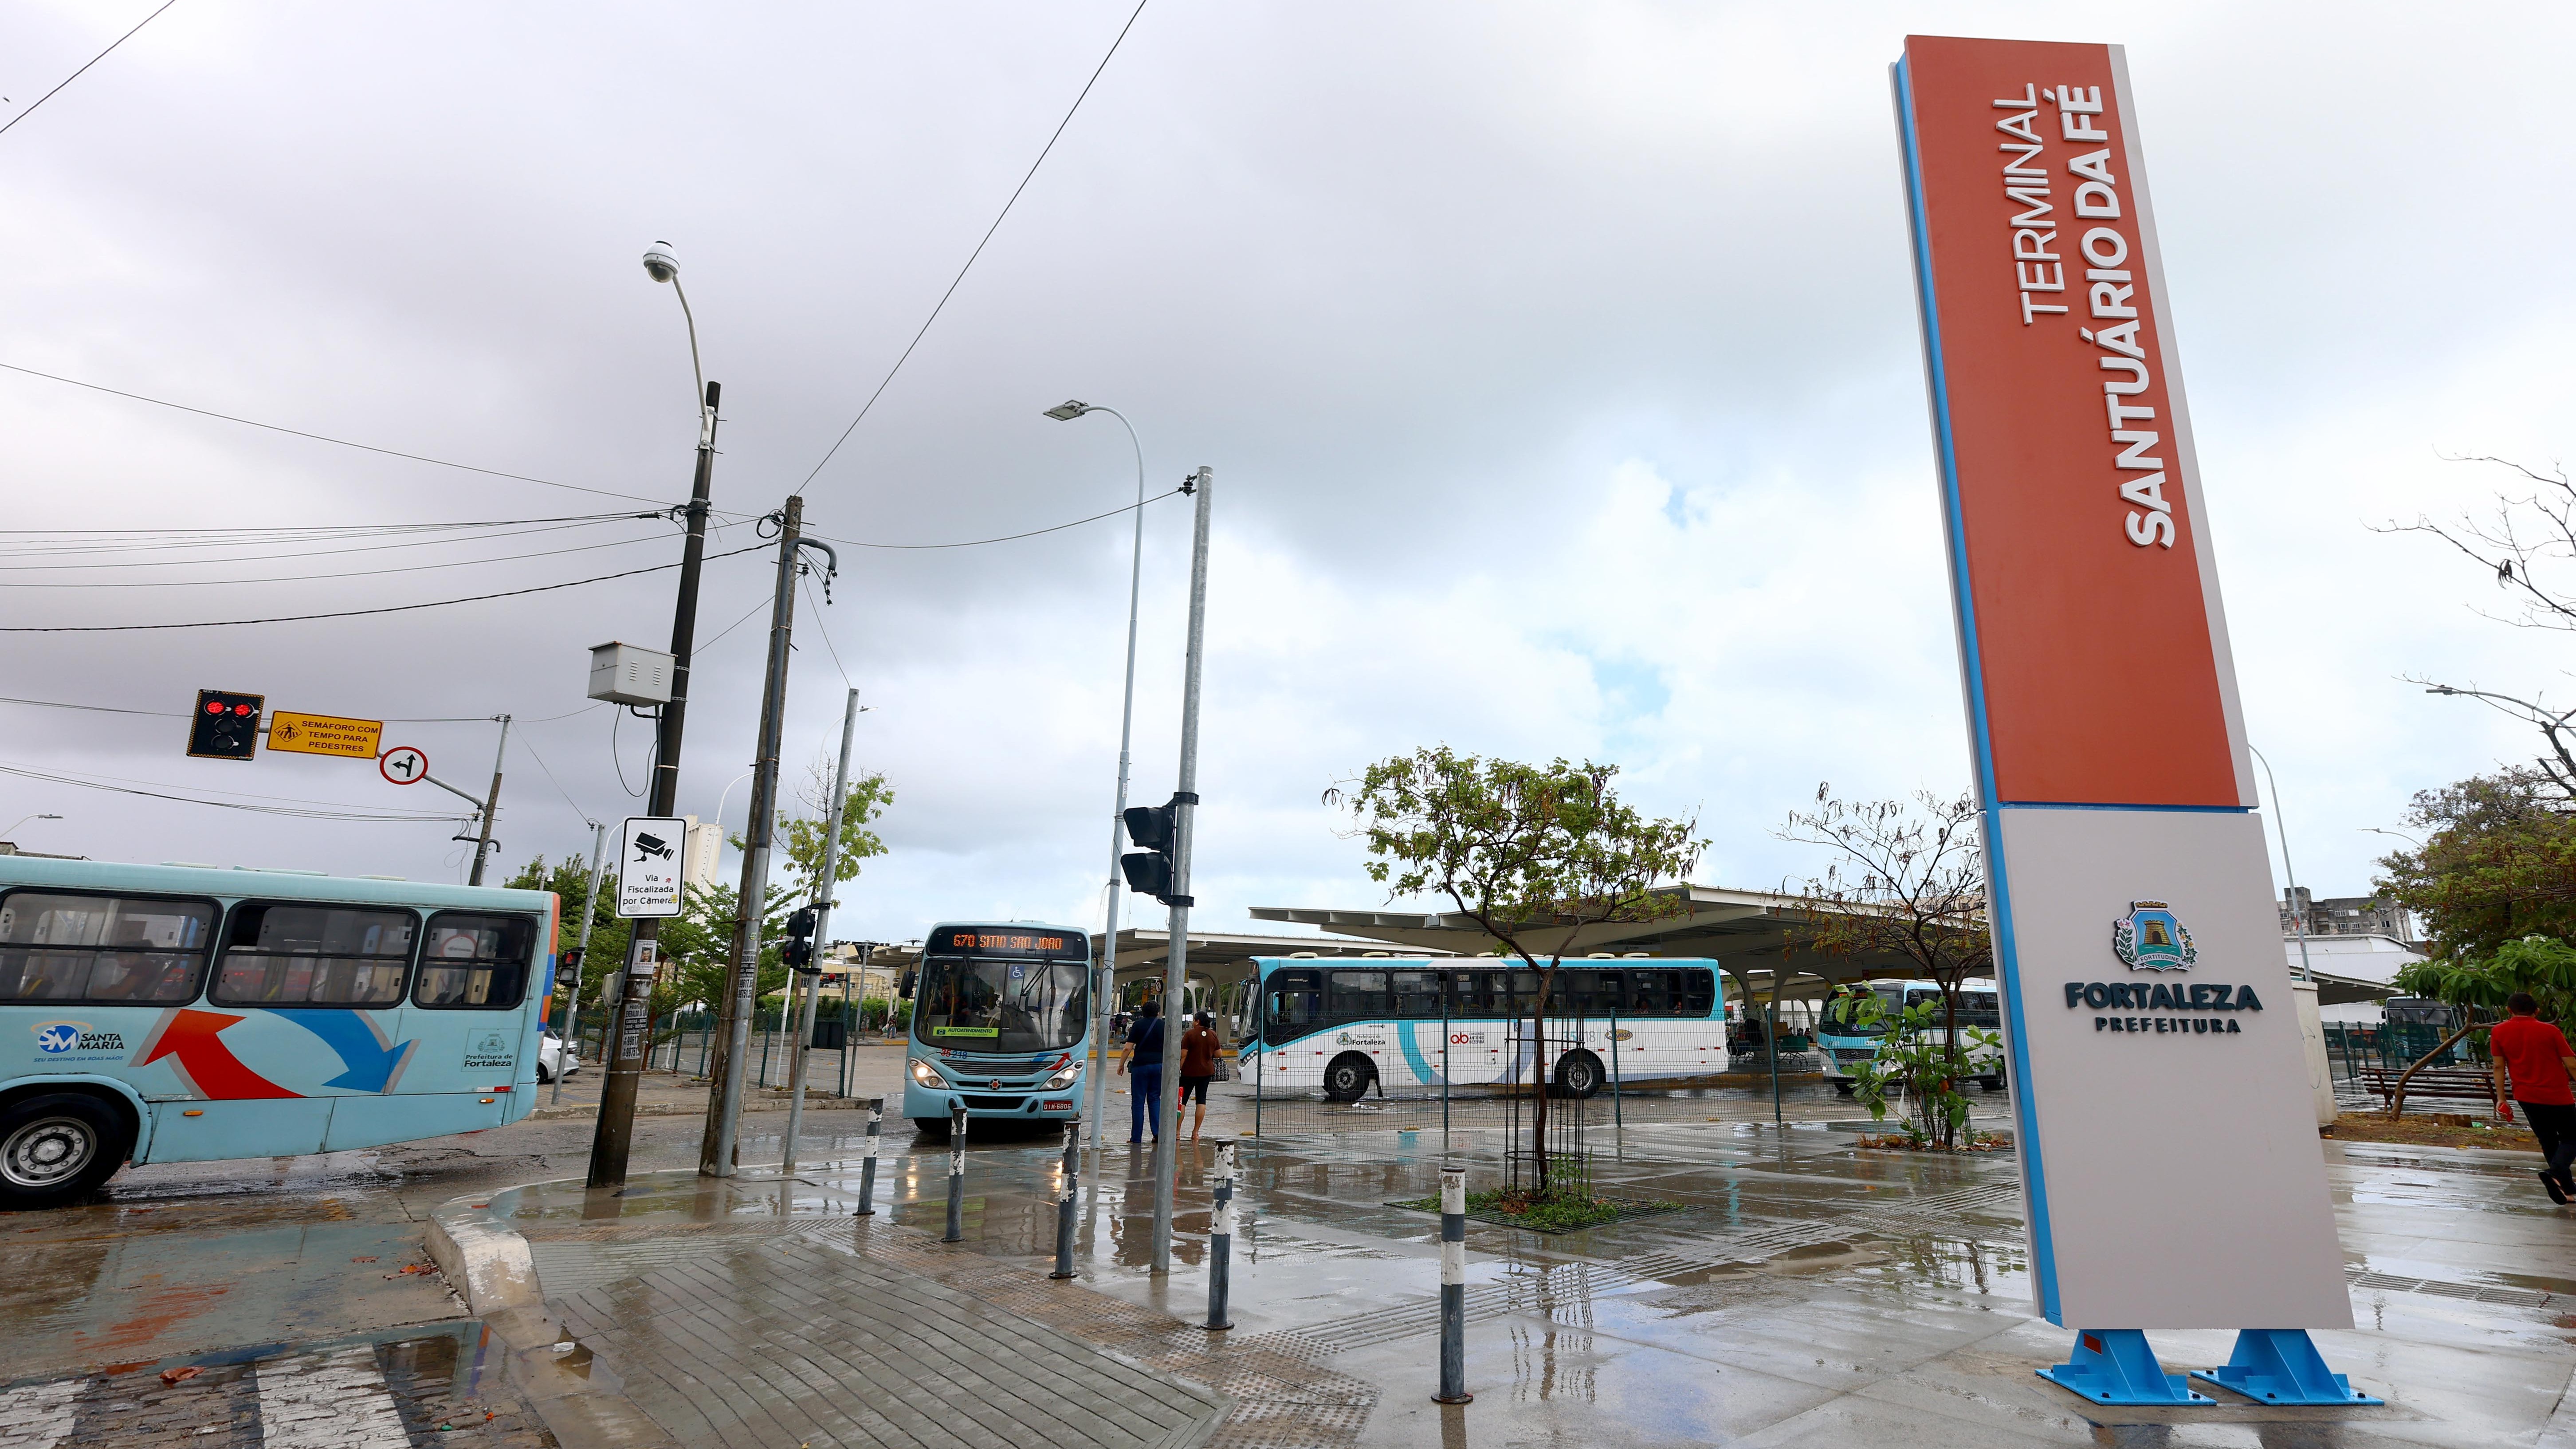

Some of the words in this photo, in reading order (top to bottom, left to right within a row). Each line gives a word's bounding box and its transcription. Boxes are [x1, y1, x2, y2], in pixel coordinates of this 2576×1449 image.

[2043, 84, 2108, 143] FÉ
[2068, 149, 2121, 219] DA
[1992, 83, 2068, 325] TERMINAL
[2080, 227, 2175, 549] SANTUÁRIO
[302, 721, 355, 731] SEMÁFORO
[309, 731, 341, 740] TEMPO
[309, 741, 364, 752] PEDESTRES
[954, 934, 975, 947] 670
[979, 935, 1007, 948] SITIO
[1010, 936, 1032, 949] SAO
[1034, 937, 1063, 950] JOAO
[2140, 954, 2179, 962] FORTITUDINE
[2065, 982, 2264, 1010] FORTALEZA
[2095, 1017, 2241, 1033] PREFEITURA
[38, 1026, 77, 1050] SM
[77, 1041, 124, 1050] MARIA
